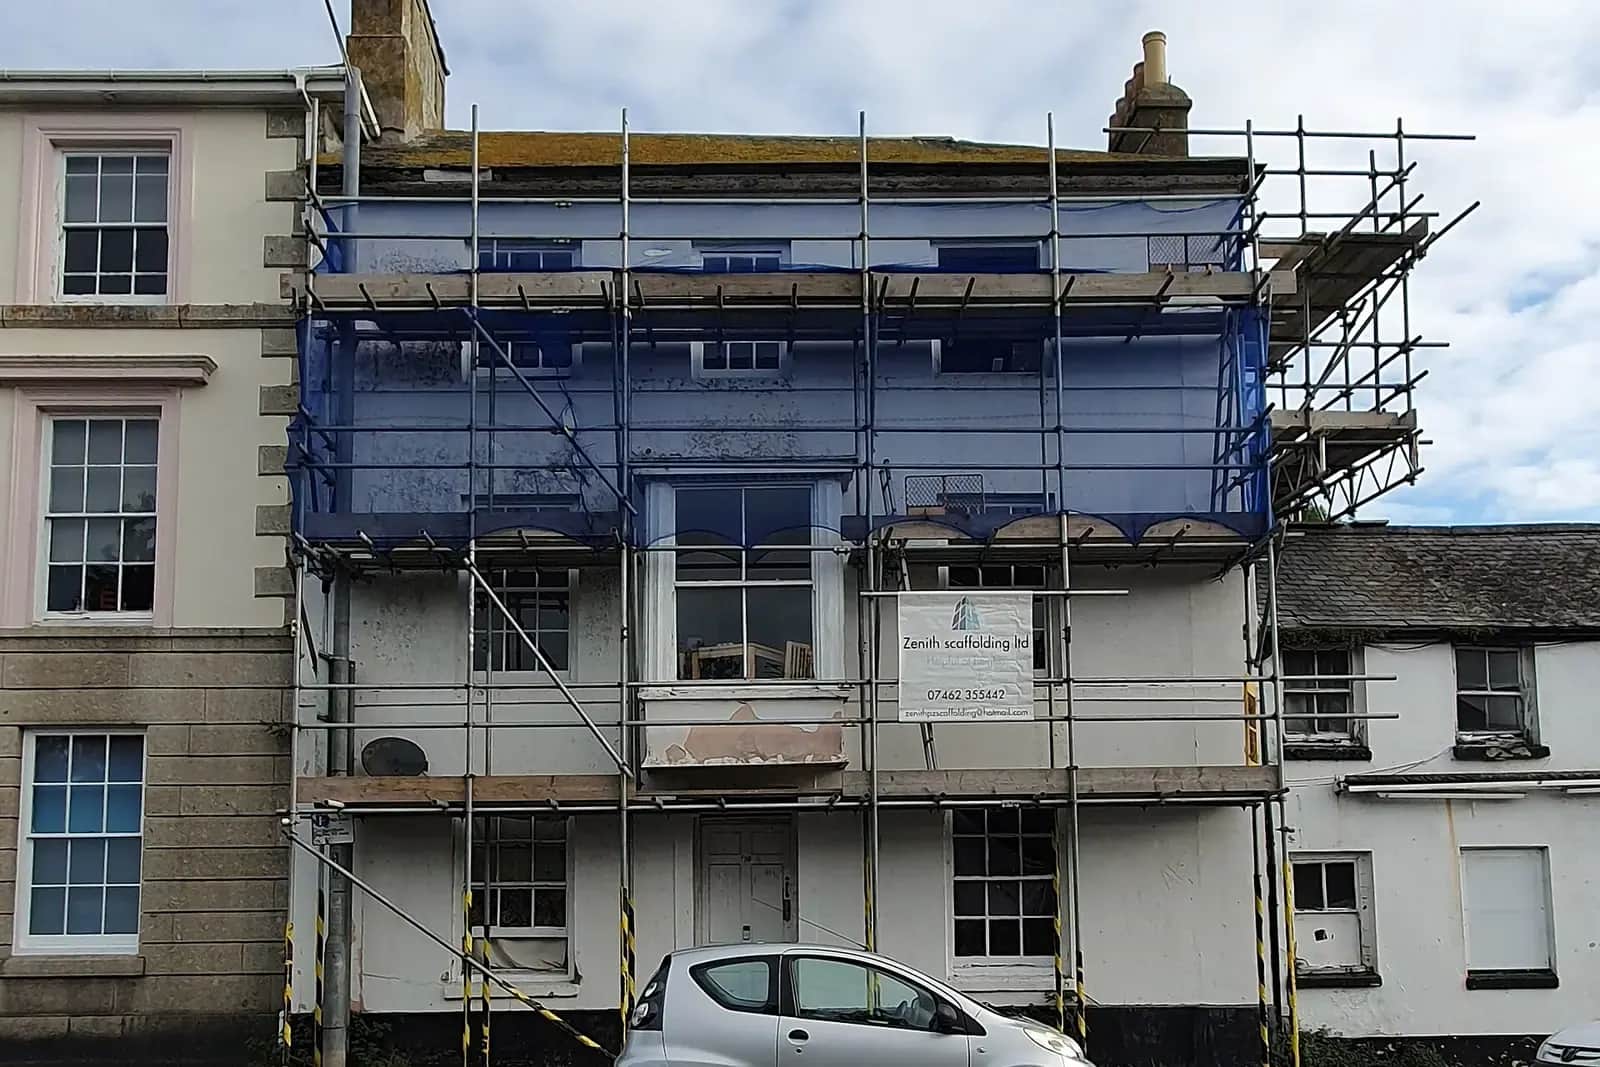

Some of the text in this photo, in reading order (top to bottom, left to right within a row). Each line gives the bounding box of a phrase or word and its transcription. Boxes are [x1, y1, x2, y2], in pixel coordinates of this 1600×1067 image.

[903, 634, 1029, 652] Zenith scaffolding ltd
[927, 689, 1005, 700] 07462 355442
